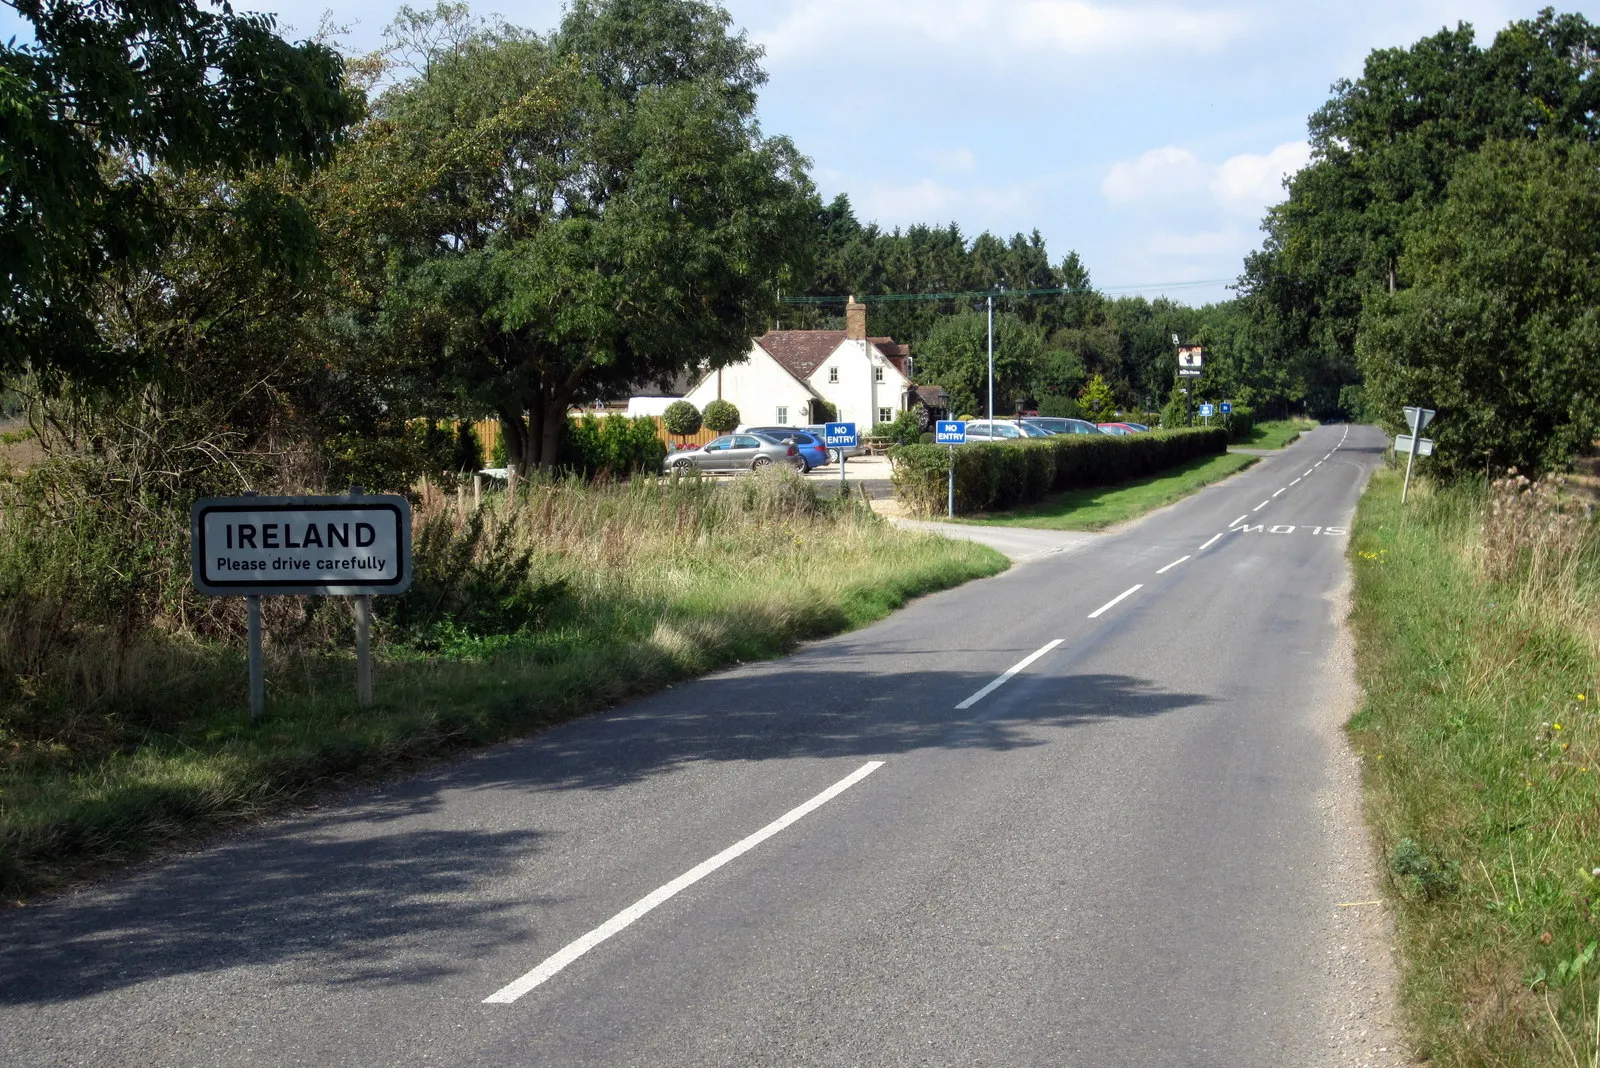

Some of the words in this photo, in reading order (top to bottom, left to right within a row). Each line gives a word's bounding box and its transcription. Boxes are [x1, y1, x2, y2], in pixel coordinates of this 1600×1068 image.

[834, 426, 847, 435] NO
[944, 424, 957, 432] NO
[827, 435, 854, 444] ENTRY
[938, 433, 964, 441] ENTRY
[1231, 524, 1347, 535] SLOW
[226, 523, 376, 548] IRELAND
[217, 557, 266, 571] Please
[272, 557, 310, 570] drive
[316, 556, 386, 571] carefully
